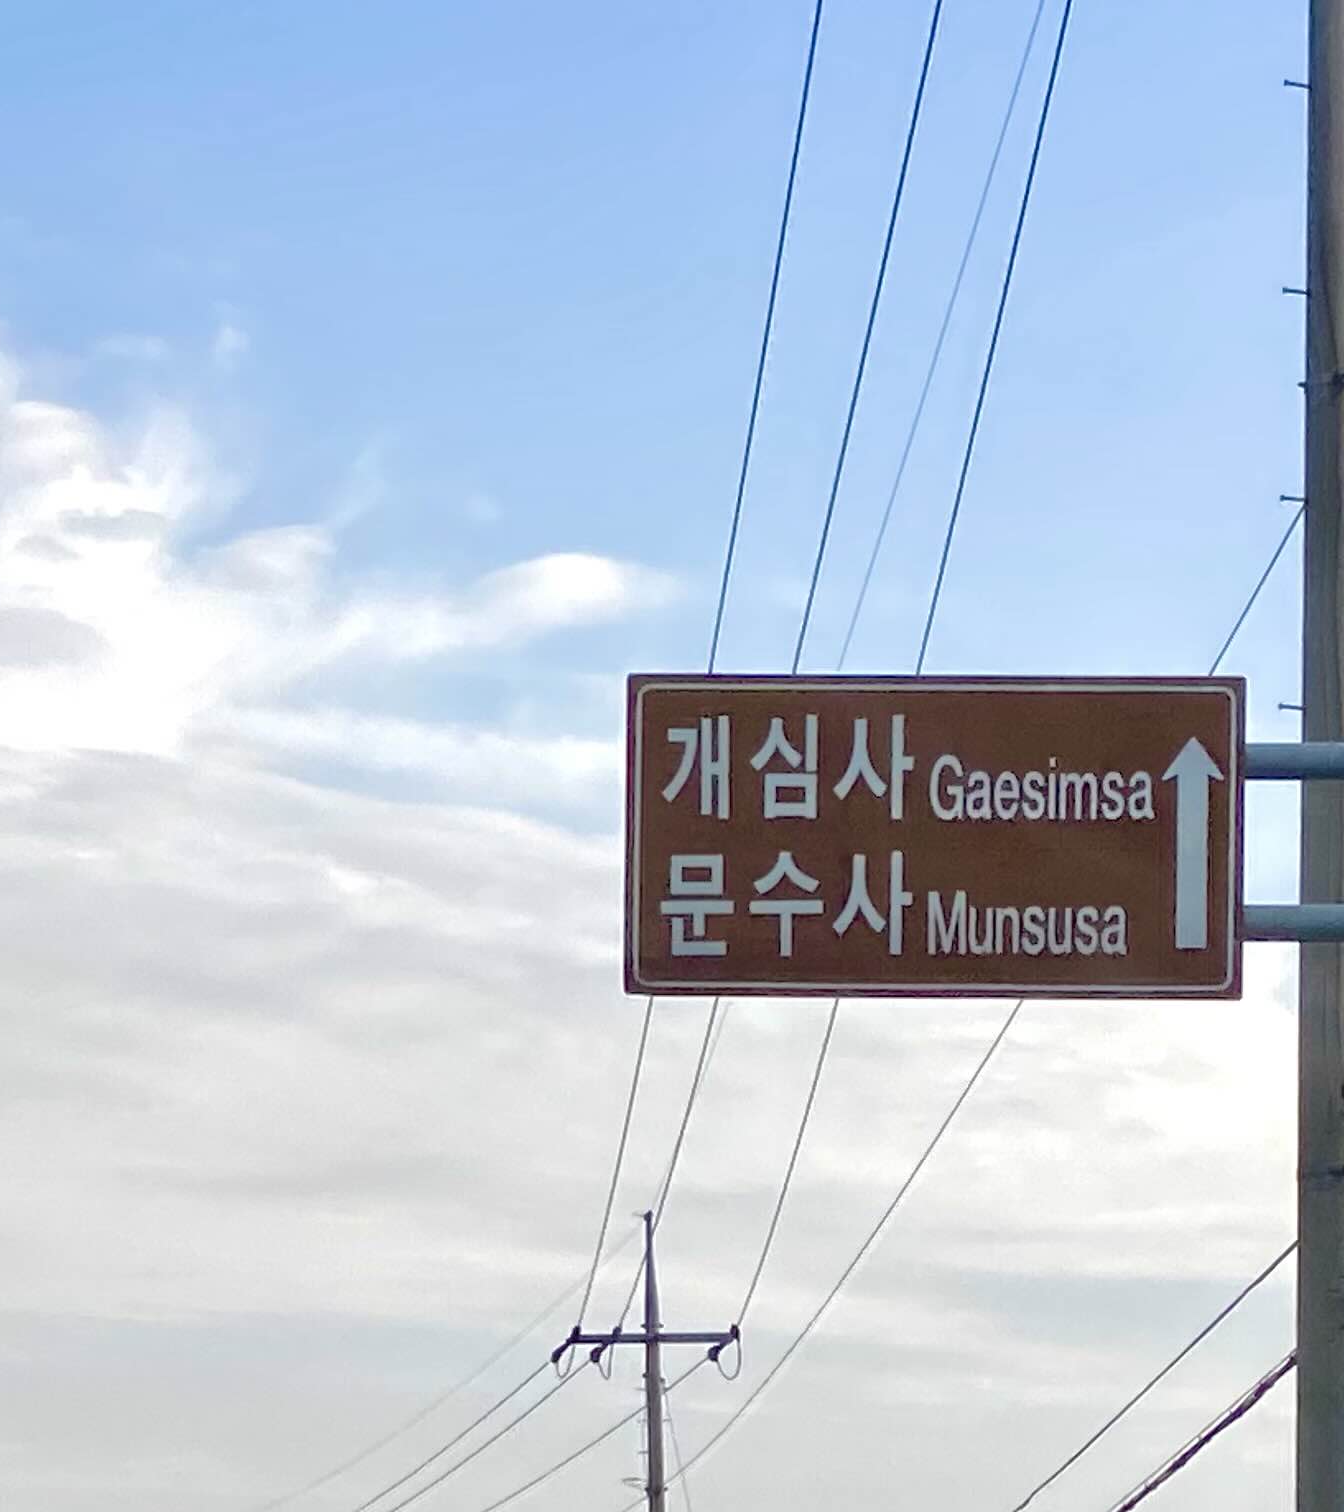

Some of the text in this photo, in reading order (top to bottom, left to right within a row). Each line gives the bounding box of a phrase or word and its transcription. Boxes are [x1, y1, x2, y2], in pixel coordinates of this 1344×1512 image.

[662, 714, 1156, 821] 개심사 Gaesimsa
[660, 850, 1128, 957] 문수사 Munsusa
